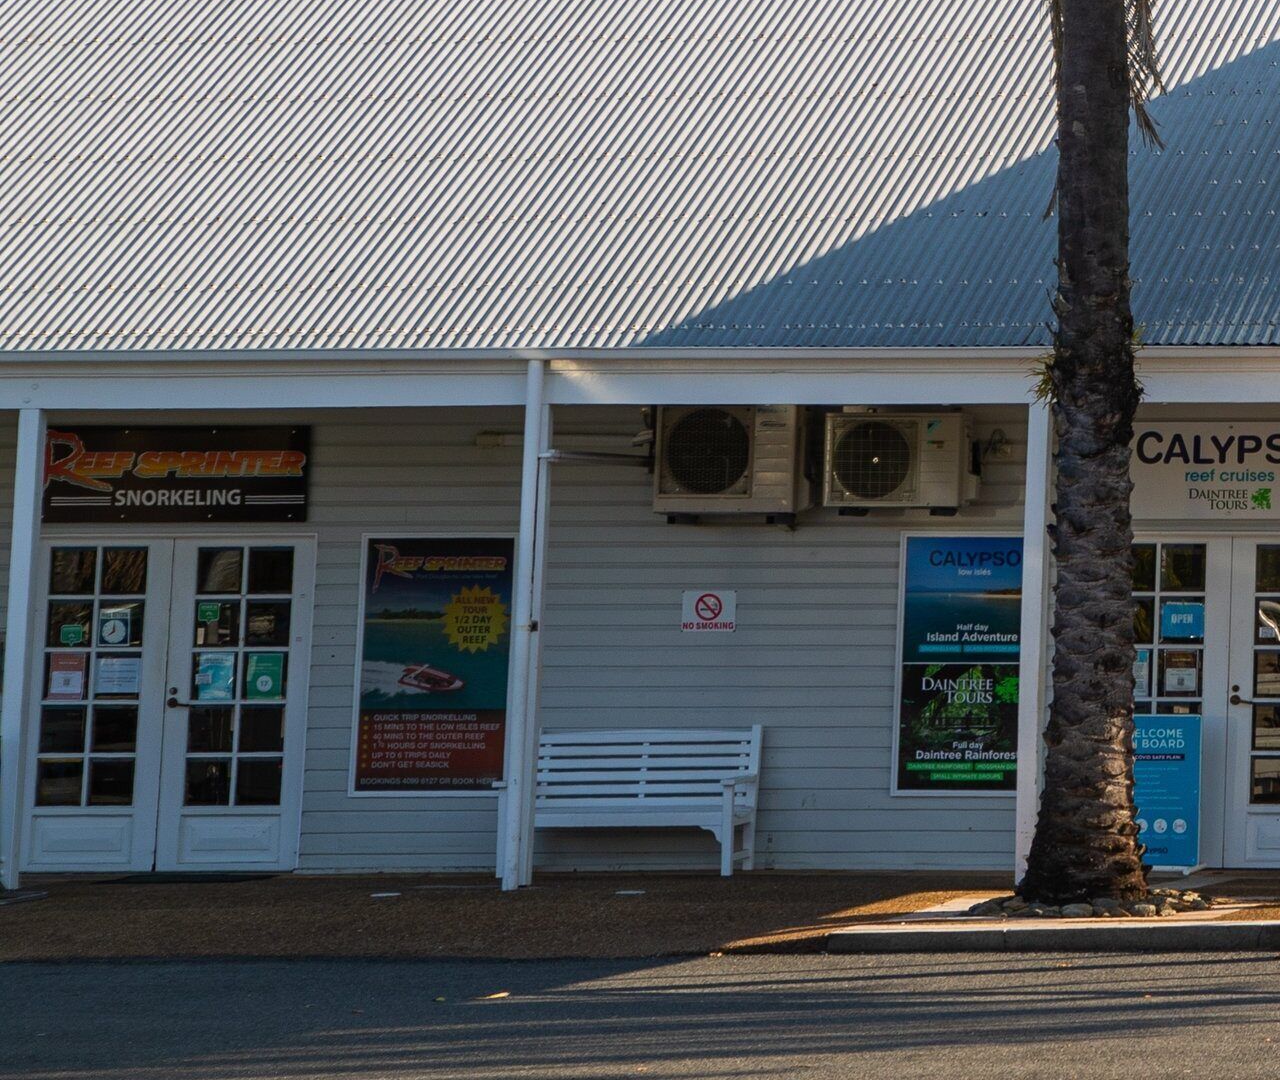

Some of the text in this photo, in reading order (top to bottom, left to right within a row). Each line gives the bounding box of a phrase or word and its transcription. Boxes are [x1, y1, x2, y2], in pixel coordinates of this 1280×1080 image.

[133, 450, 306, 478] SPRINTER
[1185, 469, 1275, 482] reef cruises
[114, 489, 241, 506] SNORKELING
[1188, 488, 1249, 500] DAINTREE
[1208, 499, 1248, 510] TOURS
[929, 549, 1021, 567] CALYPSO
[423, 556, 507, 571] SPRINTER
[472, 616, 492, 624] DAY
[1170, 613, 1194, 624] OPEN
[457, 626, 491, 634] OUTER
[682, 622, 734, 630] NO SMOKING
[956, 623, 989, 632] Half day
[462, 635, 487, 644] REEF
[926, 632, 1018, 642] Island Adventure
[921, 677, 994, 691] DAINTREE
[944, 690, 994, 704] TOURS
[1134, 728, 1183, 738] ELCOME
[952, 741, 984, 751] Full day
[1142, 739, 1185, 749] BOARD
[915, 750, 962, 760] Daintree
